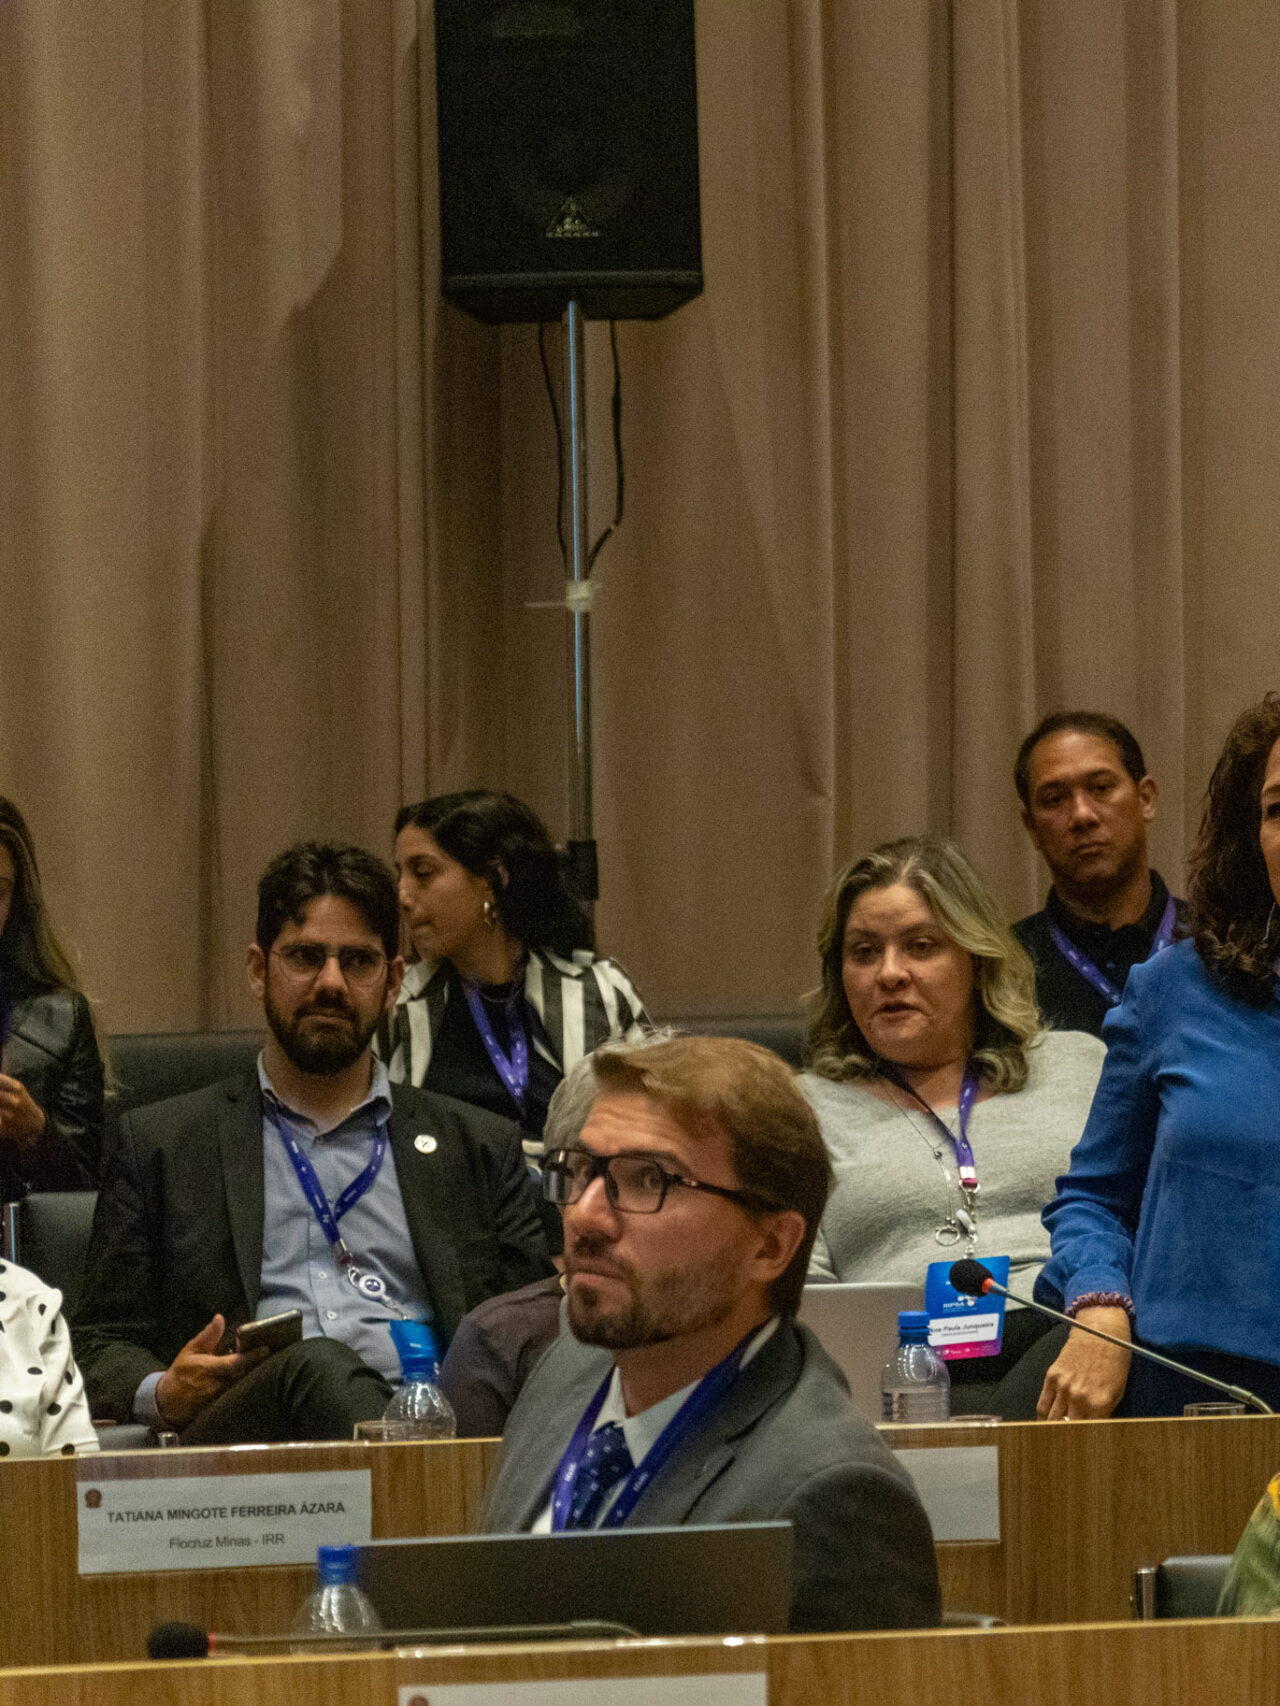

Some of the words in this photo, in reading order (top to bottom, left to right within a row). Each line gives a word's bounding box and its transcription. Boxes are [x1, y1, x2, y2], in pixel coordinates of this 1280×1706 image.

[107, 1510, 164, 1523] TATIANA
[167, 1507, 228, 1521] MINGOTE
[230, 1504, 297, 1518] FERREIRA
[300, 1501, 345, 1514] ÁZARA
[169, 1537, 213, 1549] Fiocruz
[215, 1535, 251, 1547] Minas
[262, 1533, 285, 1545] IRR
